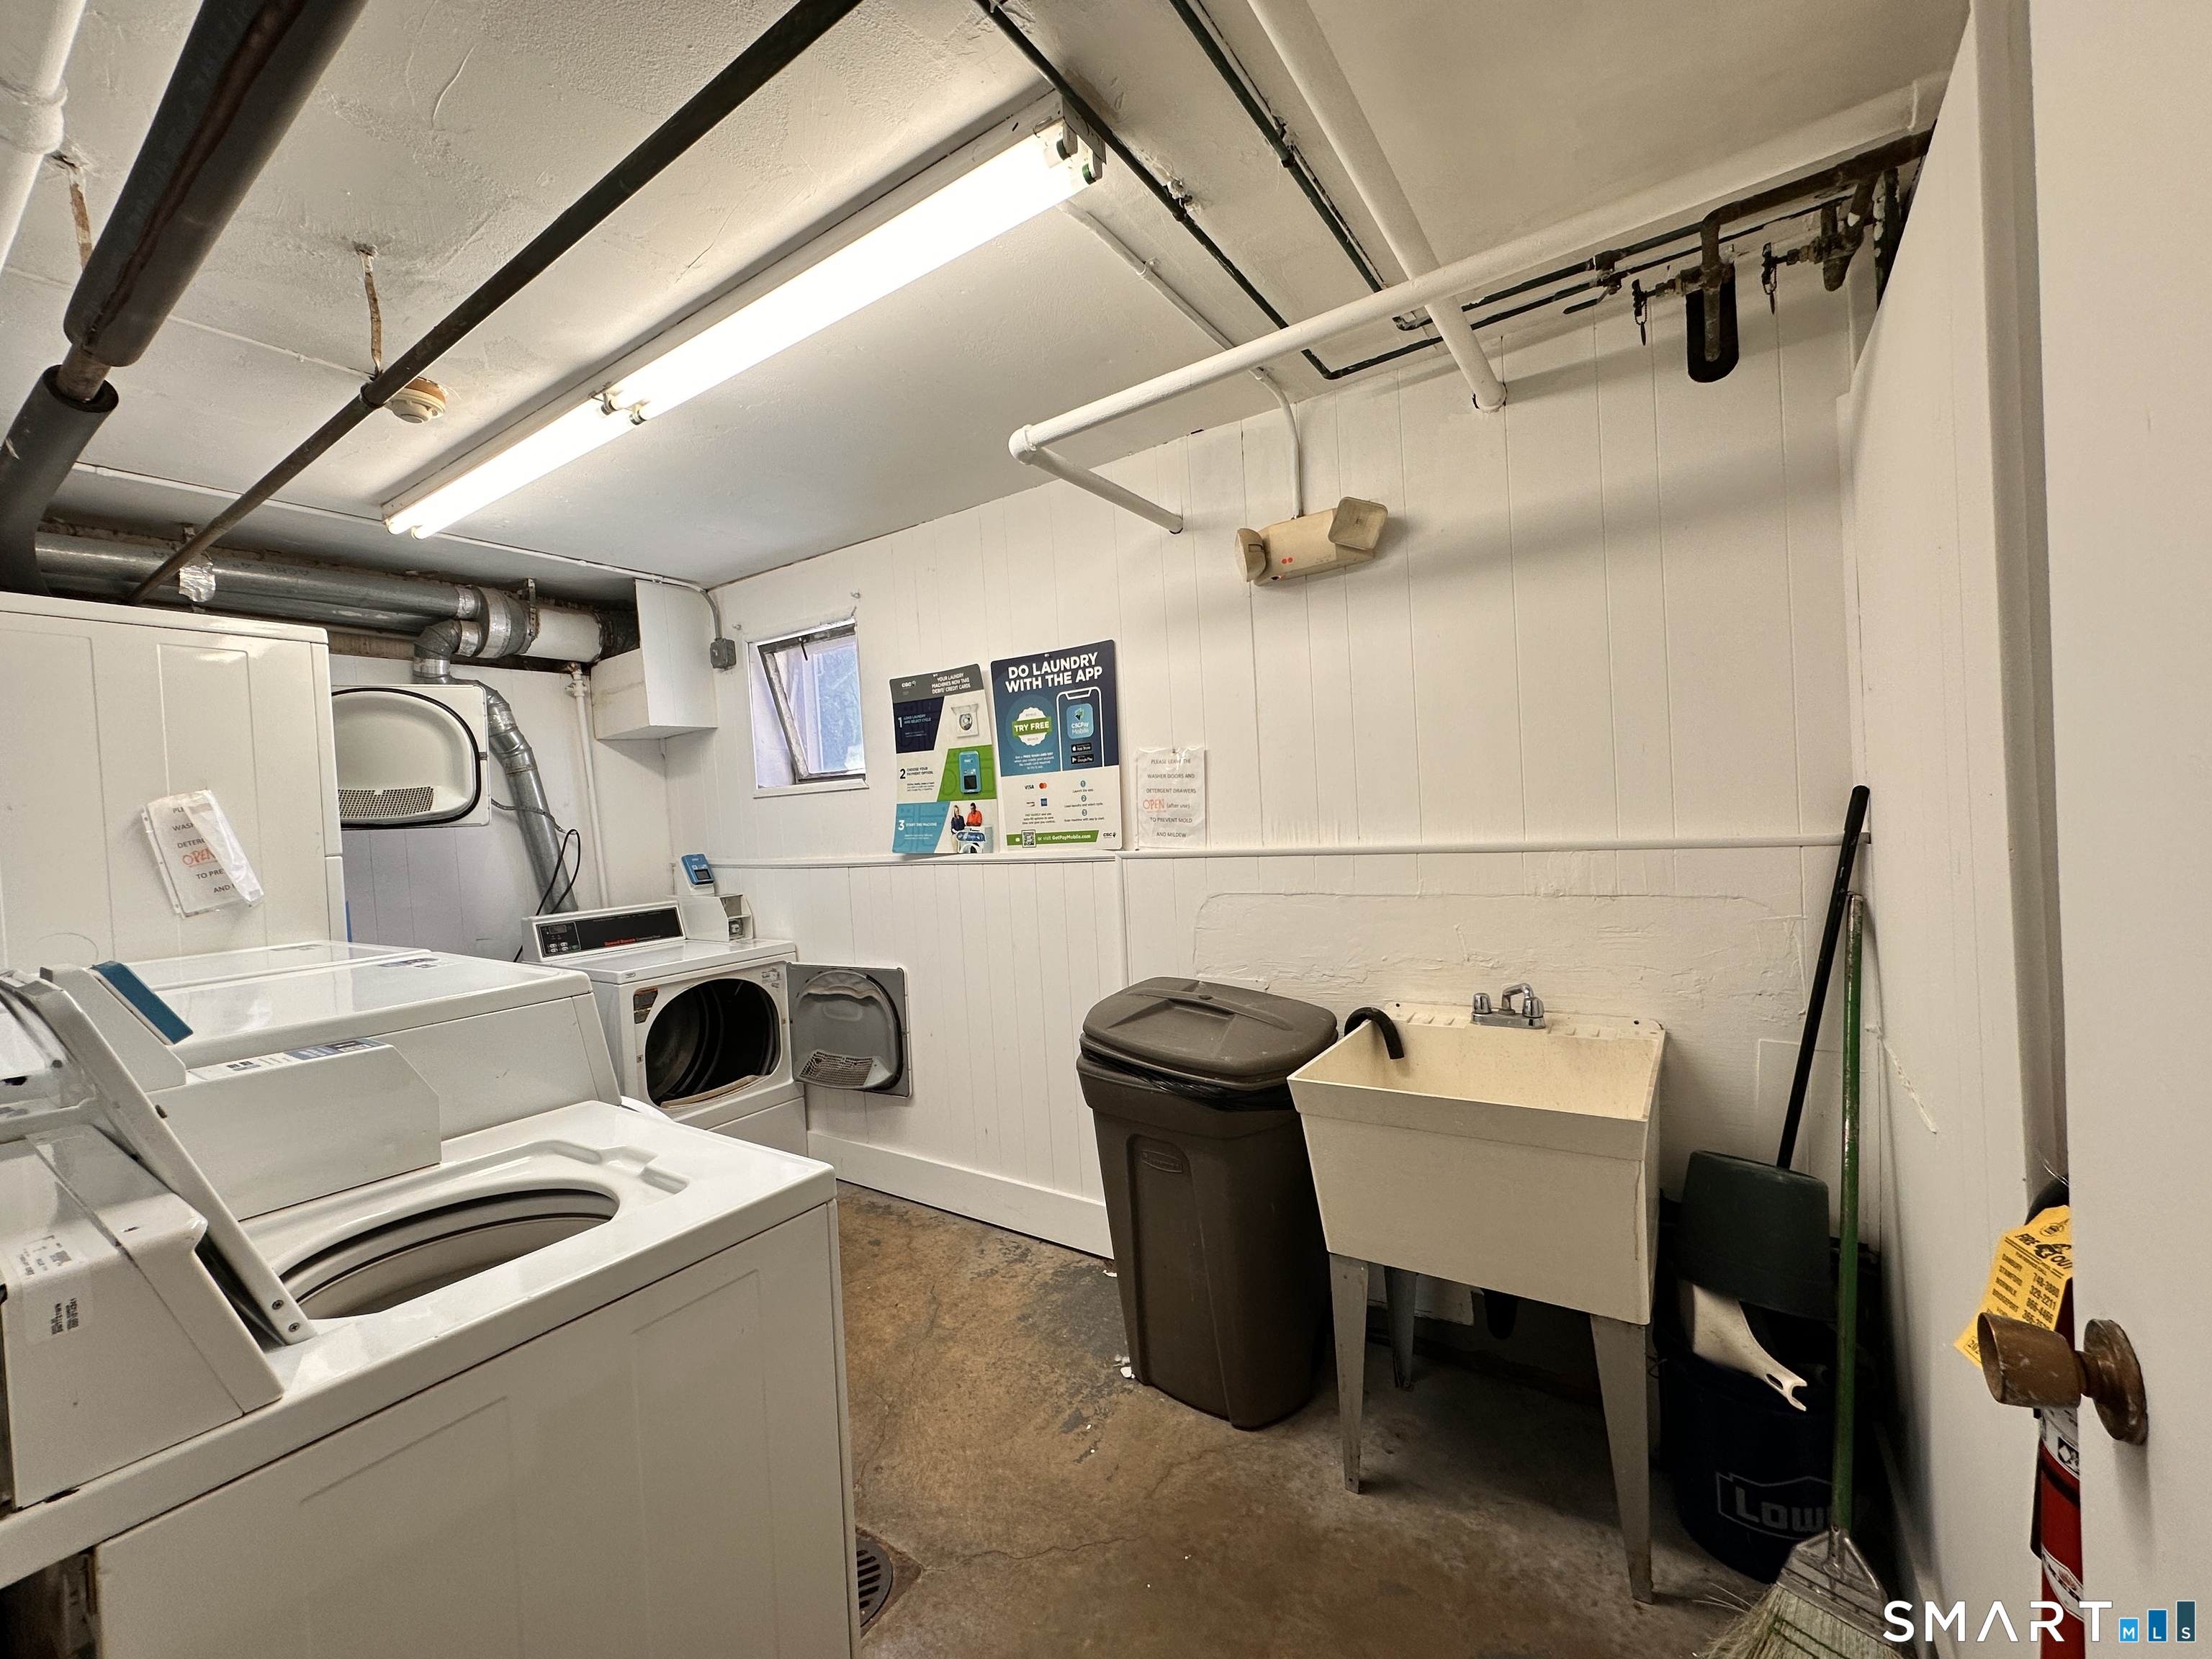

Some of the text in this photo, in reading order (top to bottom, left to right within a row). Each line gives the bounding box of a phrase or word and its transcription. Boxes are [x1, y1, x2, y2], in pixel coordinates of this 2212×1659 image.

[1008, 652, 1098, 680] DO LAUNDRY
[1005, 666, 1103, 693] WITH THE APP
[898, 716, 902, 728] 1
[1014, 721, 1050, 733] TRY FREE
[899, 768, 906, 779] 2
[1143, 799, 1164, 810] OPEN
[172, 822, 194, 832] WASH
[898, 820, 905, 830] 3
[182, 848, 217, 866] OPEN
[214, 884, 230, 893] AND
[2015, 1233, 2040, 1246] FIRE
[1999, 1265, 2023, 1286] STAMFORD
